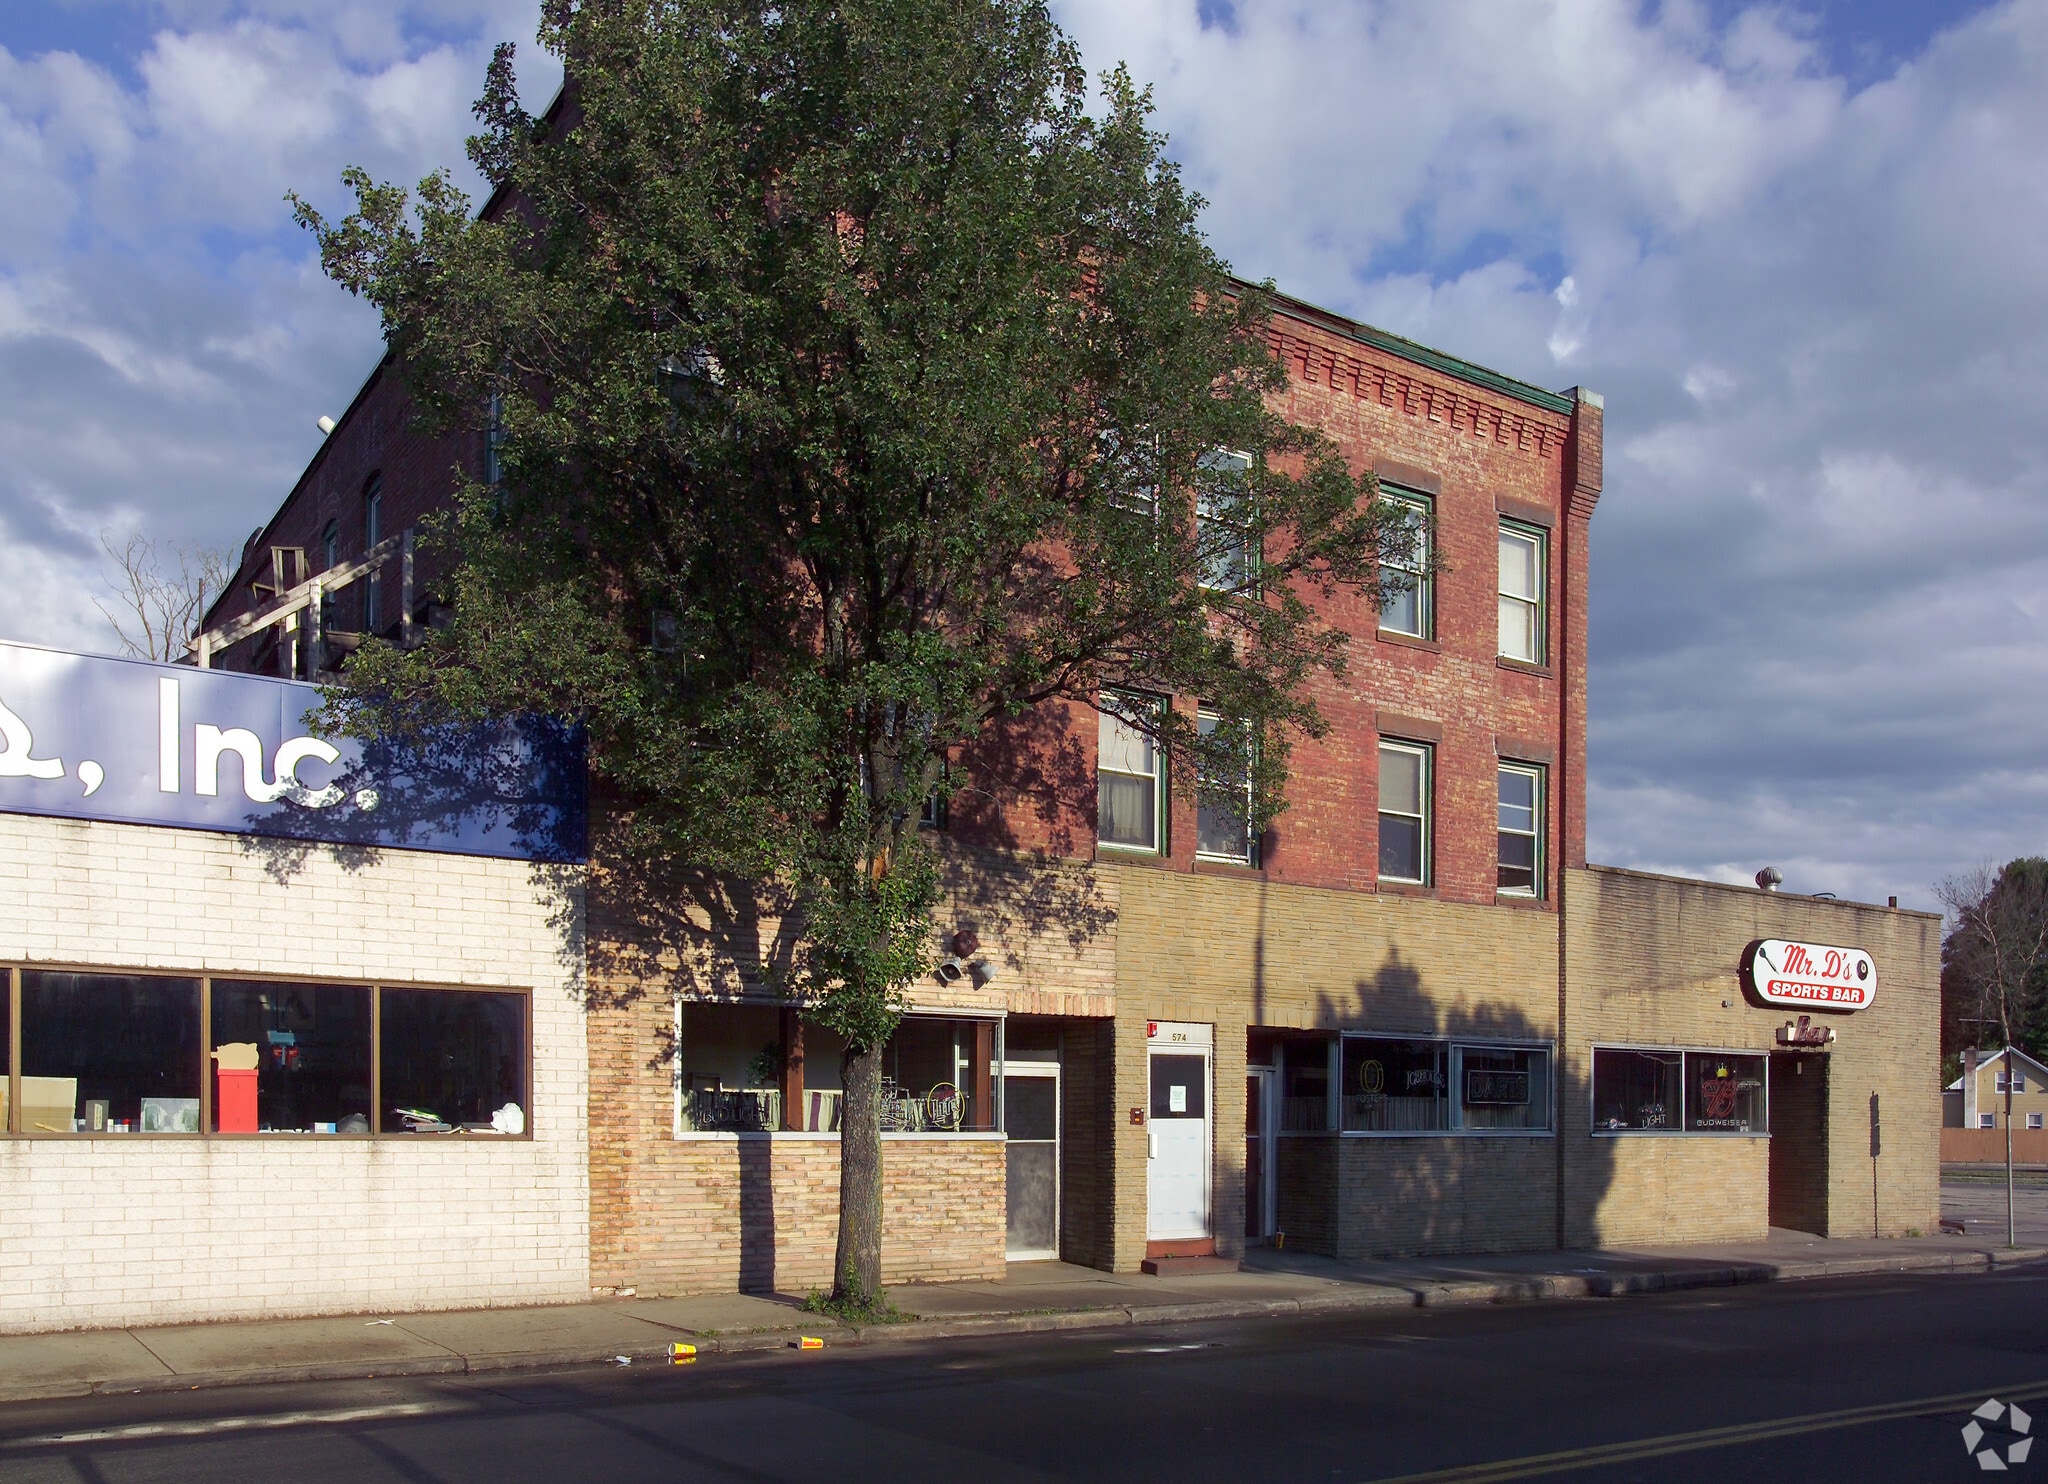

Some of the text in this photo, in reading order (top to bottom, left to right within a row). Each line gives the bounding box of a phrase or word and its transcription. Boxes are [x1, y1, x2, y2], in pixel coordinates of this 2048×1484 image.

[158, 676, 379, 812] Inc.
[1784, 944, 1852, 981] Mr. D's
[1772, 982, 1861, 1002] SPORTS BAR
[1172, 1033, 1187, 1042] 574
[1471, 1075, 1527, 1100] DARTS
[1642, 1114, 1666, 1129] LIGHT
[1696, 1119, 1748, 1127] BUDWEISER
